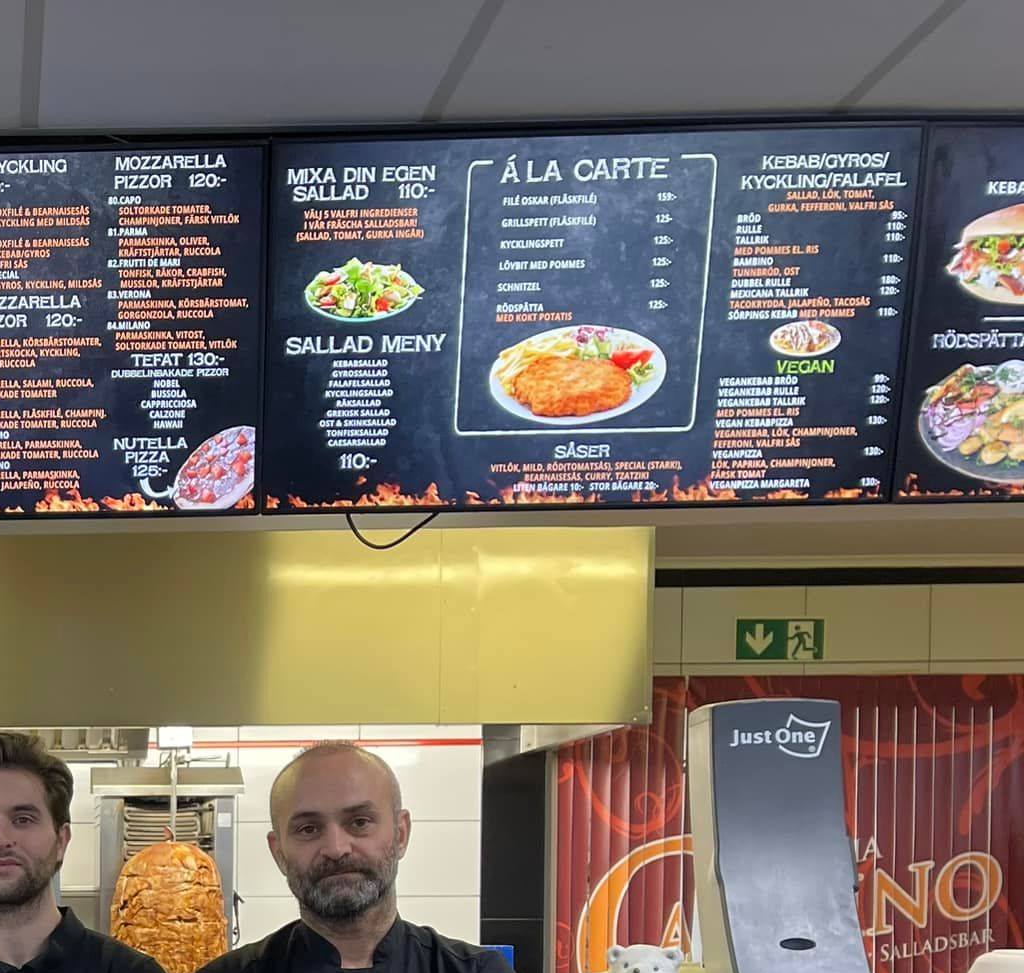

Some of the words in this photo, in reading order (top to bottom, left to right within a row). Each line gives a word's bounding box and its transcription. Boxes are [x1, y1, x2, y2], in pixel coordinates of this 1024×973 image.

[115, 155, 226, 170] MOZZARELLA
[762, 152, 890, 170] KEBAB/GYROS/
[287, 168, 337, 185] MIXA
[343, 167, 376, 183] DIN
[382, 165, 435, 181] EGEN
[526, 162, 562, 182] LA
[574, 158, 669, 181] CARTE
[114, 175, 172, 188] PIZZOR
[189, 174, 226, 187] 120:-
[741, 172, 907, 190] KYCKLING/FALAFEL
[293, 186, 369, 201] SALLAD
[399, 184, 435, 199] 110:-
[521, 195, 548, 205] OSKAR
[331, 209, 358, 218] VALFRI
[360, 208, 417, 217] INGREDIENSER
[737, 212, 761, 223] BRÖD
[502, 217, 547, 227] GRILLSPETT
[736, 225, 761, 233] RULLE
[500, 239, 564, 249] KYCKLINGSPETT
[735, 235, 769, 244] TALLRIK
[530, 260, 547, 270] MED
[549, 260, 585, 269] POMMES
[733, 257, 774, 266] BAMBINO
[497, 282, 541, 292] SCHNITZEL
[731, 278, 764, 287] DUBBEL
[766, 278, 791, 286] RULLE
[730, 289, 774, 298] MEXICANA
[775, 288, 808, 297] TALLRIK
[46, 314, 82, 326] 120:-
[539, 312, 572, 321] POTATIS
[286, 335, 373, 354] SALLAD
[382, 334, 446, 353] MENY
[131, 354, 182, 366] TEFAT
[188, 353, 224, 365] 130:-
[777, 360, 834, 373] VEGAN
[153, 379, 180, 388] NOBEL
[151, 390, 186, 398] BUSSOLA
[325, 389, 393, 397] KYCKLINGSALLAD
[149, 410, 185, 418] CALZONE
[114, 437, 187, 450] NUTELLA
[554, 442, 610, 459] SÅSER
[125, 451, 169, 463] PIZZA
[339, 454, 377, 469] 110:-
[132, 465, 168, 476] 125:-
[731, 728, 772, 746] Just
[775, 728, 816, 744] One
[880, 928, 994, 962] SALLADSBAR
